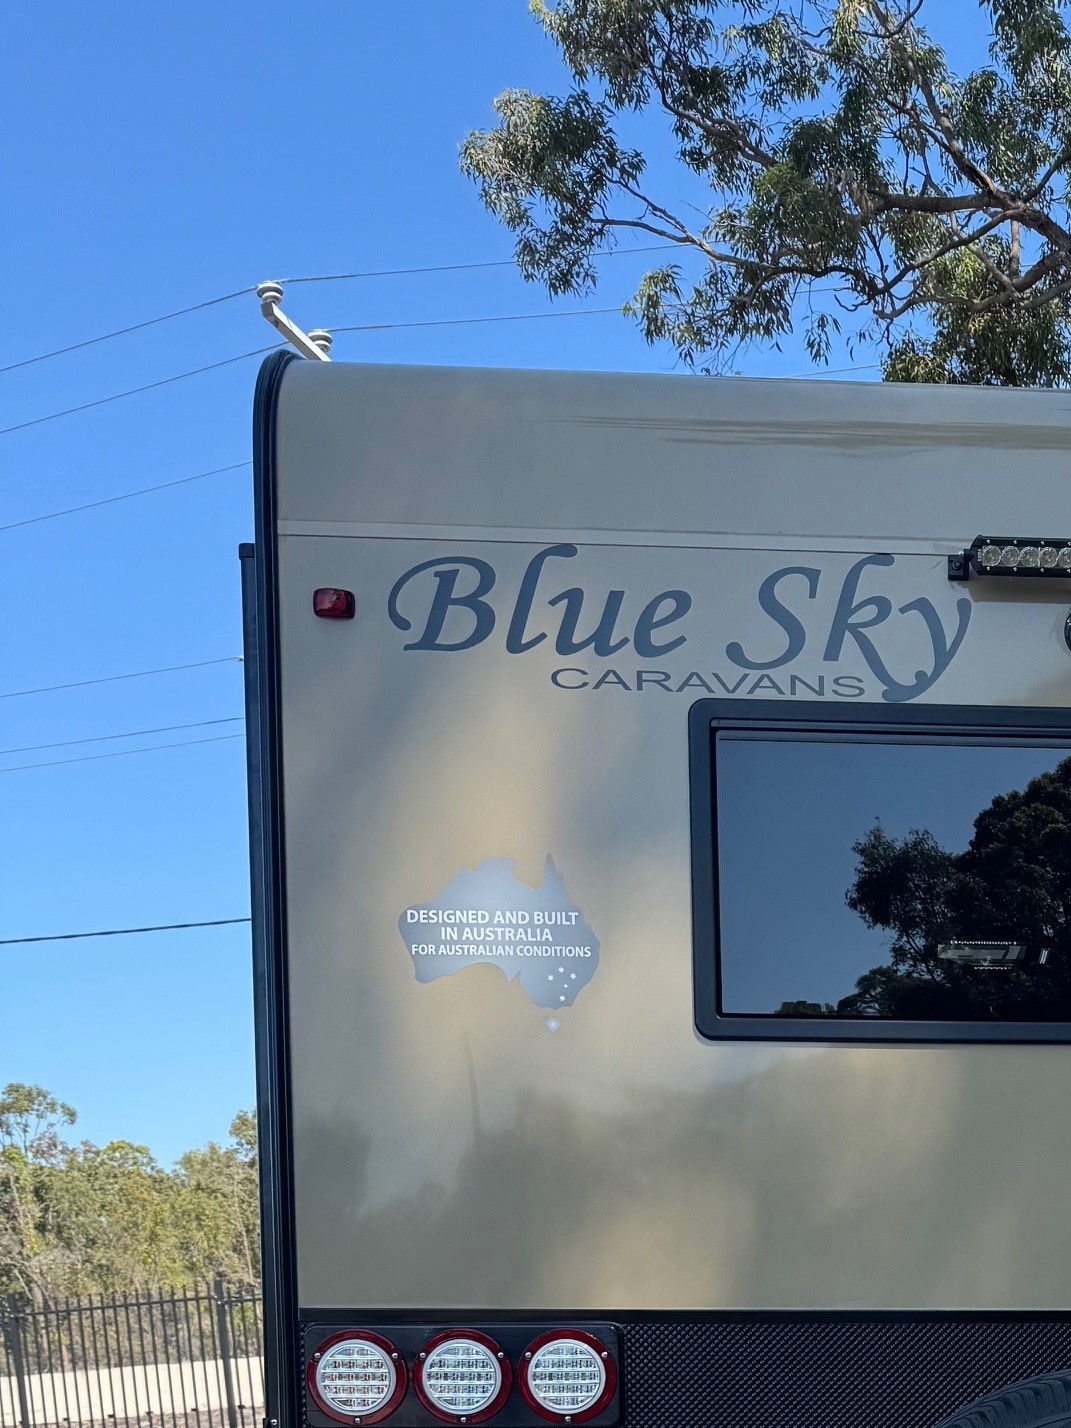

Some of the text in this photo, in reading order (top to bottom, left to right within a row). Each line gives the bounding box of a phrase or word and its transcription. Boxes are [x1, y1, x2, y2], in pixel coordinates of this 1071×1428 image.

[388, 544, 973, 702] Blue Sky
[551, 667, 866, 698] CARAVANS
[406, 909, 579, 926] DESIGNED AND BUILT
[440, 926, 553, 942] IN AUSTRALIA
[411, 944, 592, 958] FOR AUSTRALIAN CONDITIONS
